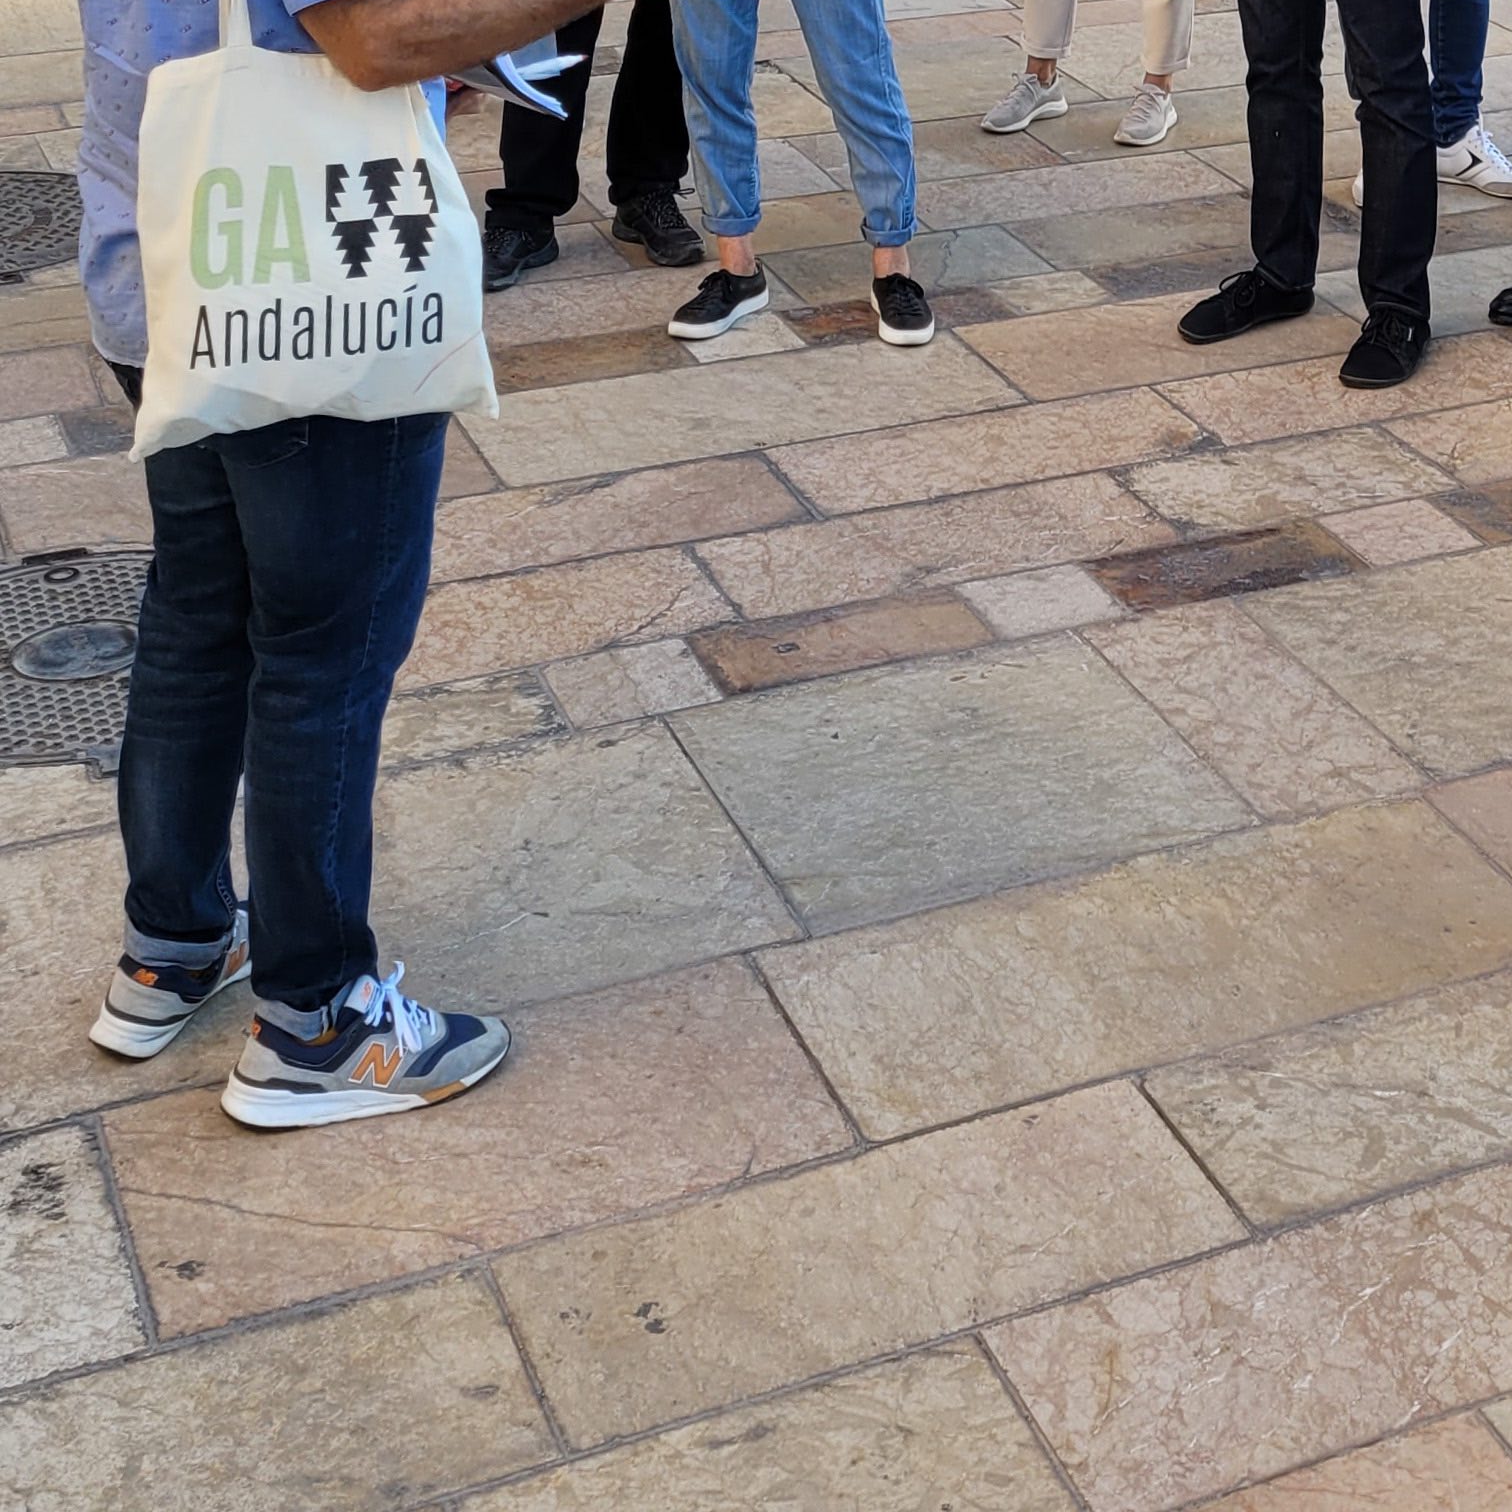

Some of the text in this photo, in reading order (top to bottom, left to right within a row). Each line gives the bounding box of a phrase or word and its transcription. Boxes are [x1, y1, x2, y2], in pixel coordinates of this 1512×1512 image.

[189, 164, 311, 291] GA
[189, 283, 444, 370] Andalucía
[348, 1041, 406, 1089] N
